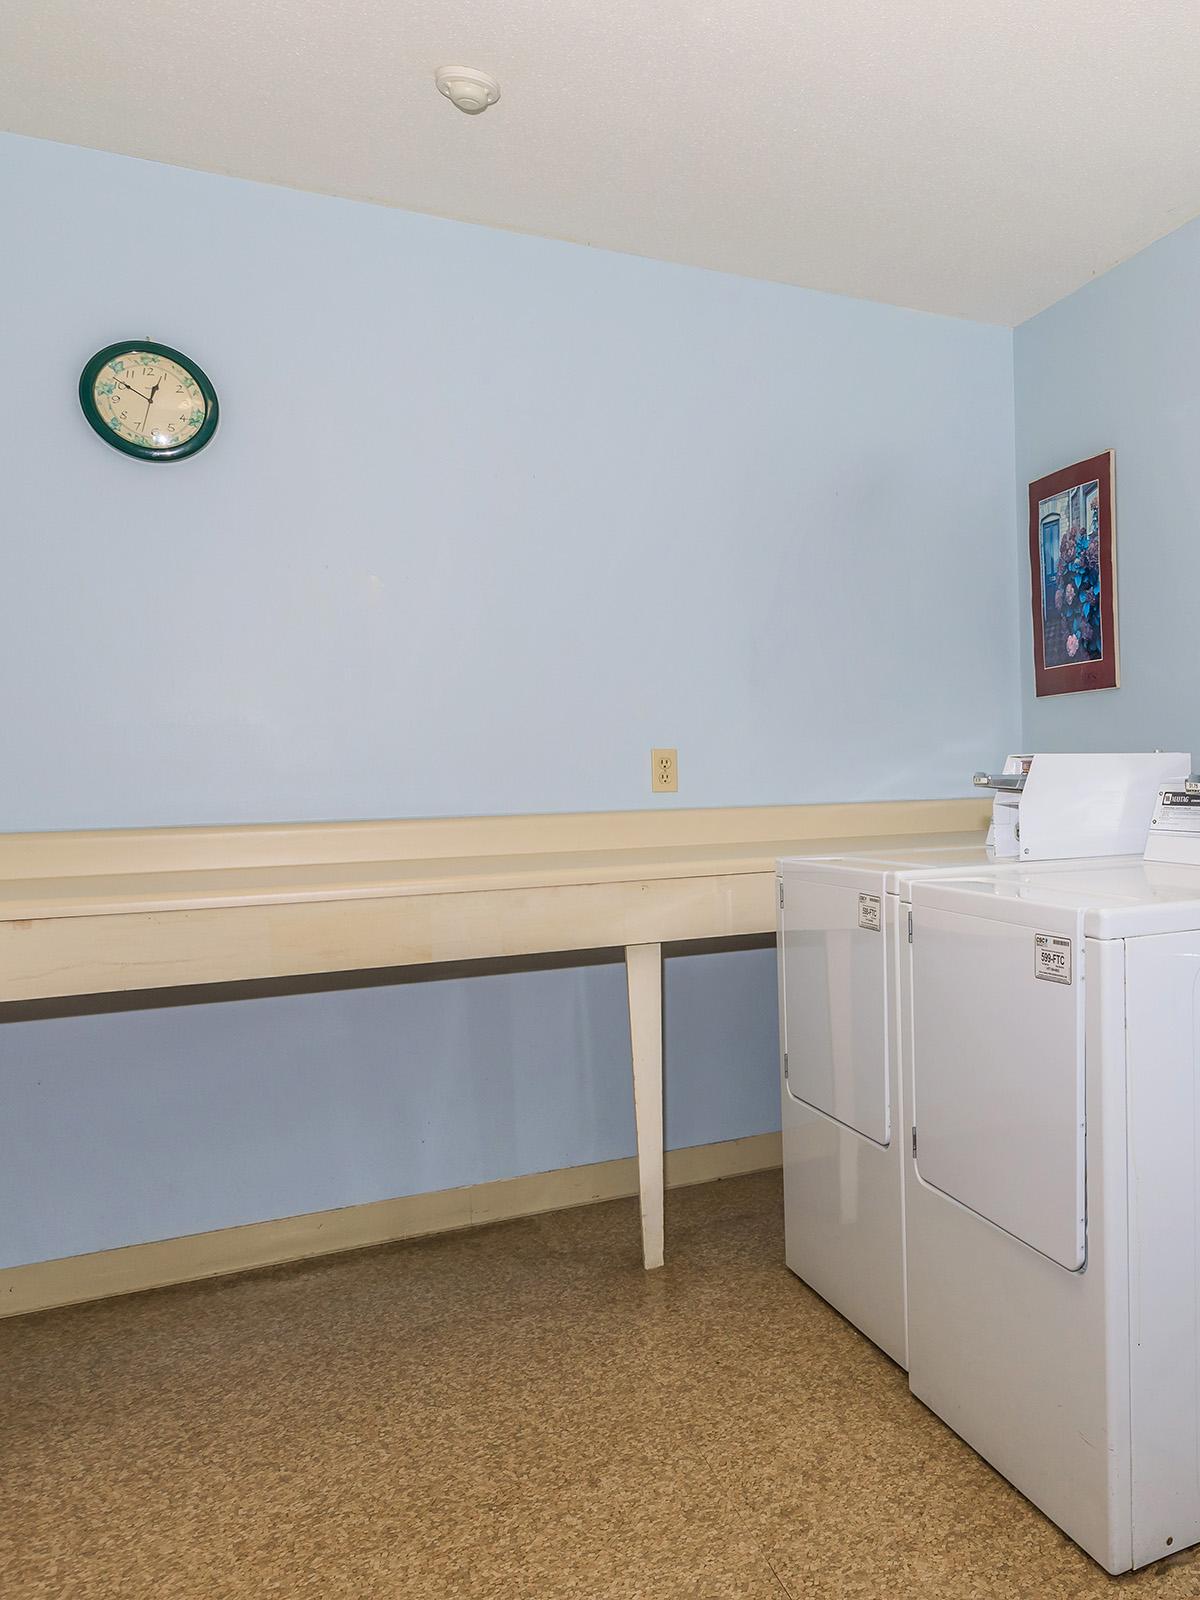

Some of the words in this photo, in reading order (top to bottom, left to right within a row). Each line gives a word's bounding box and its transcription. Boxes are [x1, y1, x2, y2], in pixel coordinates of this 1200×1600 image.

[126, 370, 134, 378] 11
[142, 367, 154, 376] 12
[175, 384, 184, 394] 2
[111, 395, 121, 404] 9
[119, 410, 128, 420] 8
[179, 414, 188, 423] 4
[134, 422, 141, 431] 7
[167, 423, 176, 433] 5
